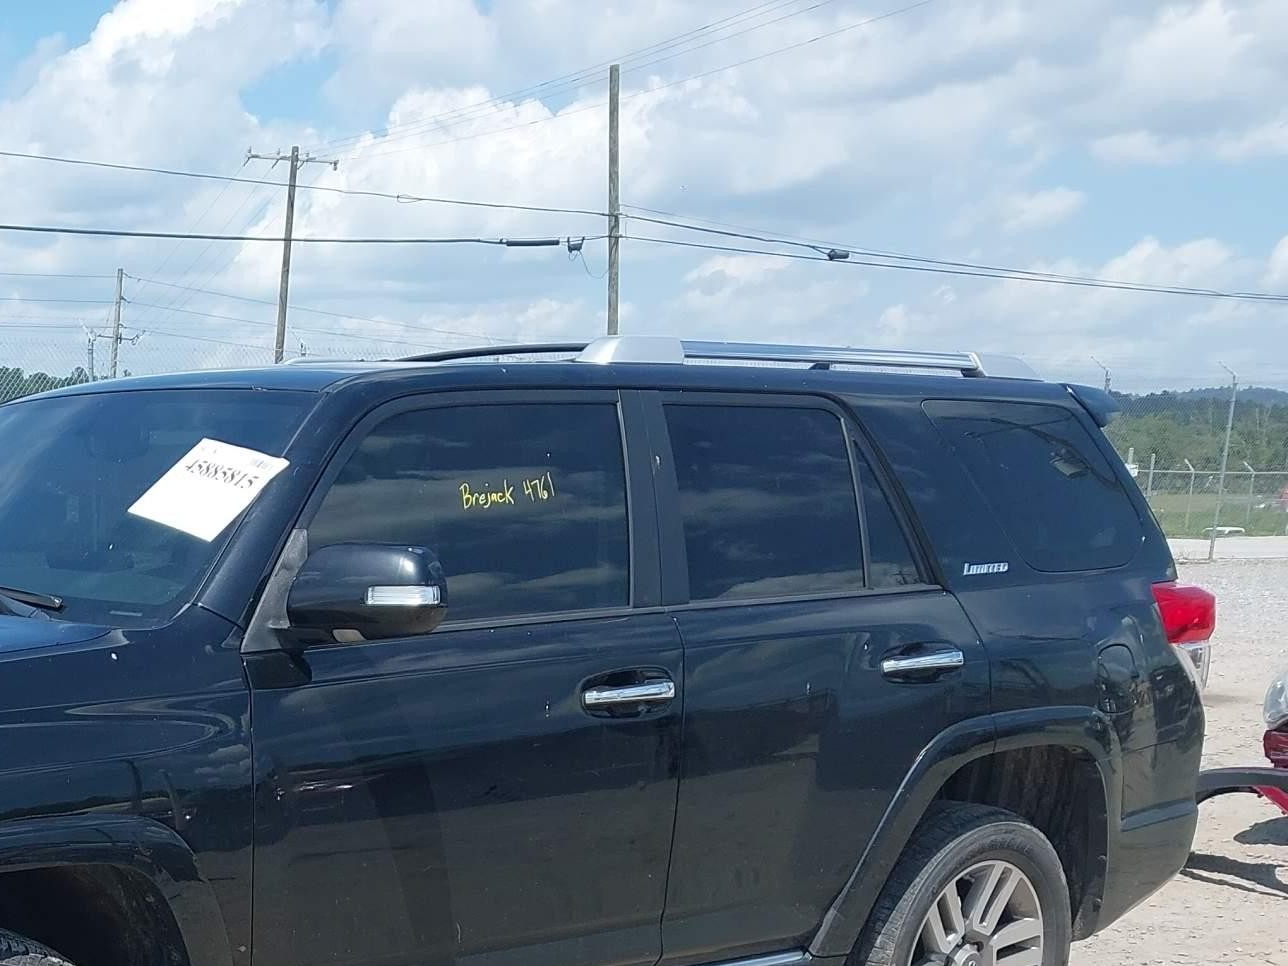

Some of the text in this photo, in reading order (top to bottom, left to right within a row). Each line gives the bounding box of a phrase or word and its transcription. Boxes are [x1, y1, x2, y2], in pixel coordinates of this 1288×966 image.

[185, 459, 260, 489] 45885815
[459, 471, 555, 510] Brejack 4761
